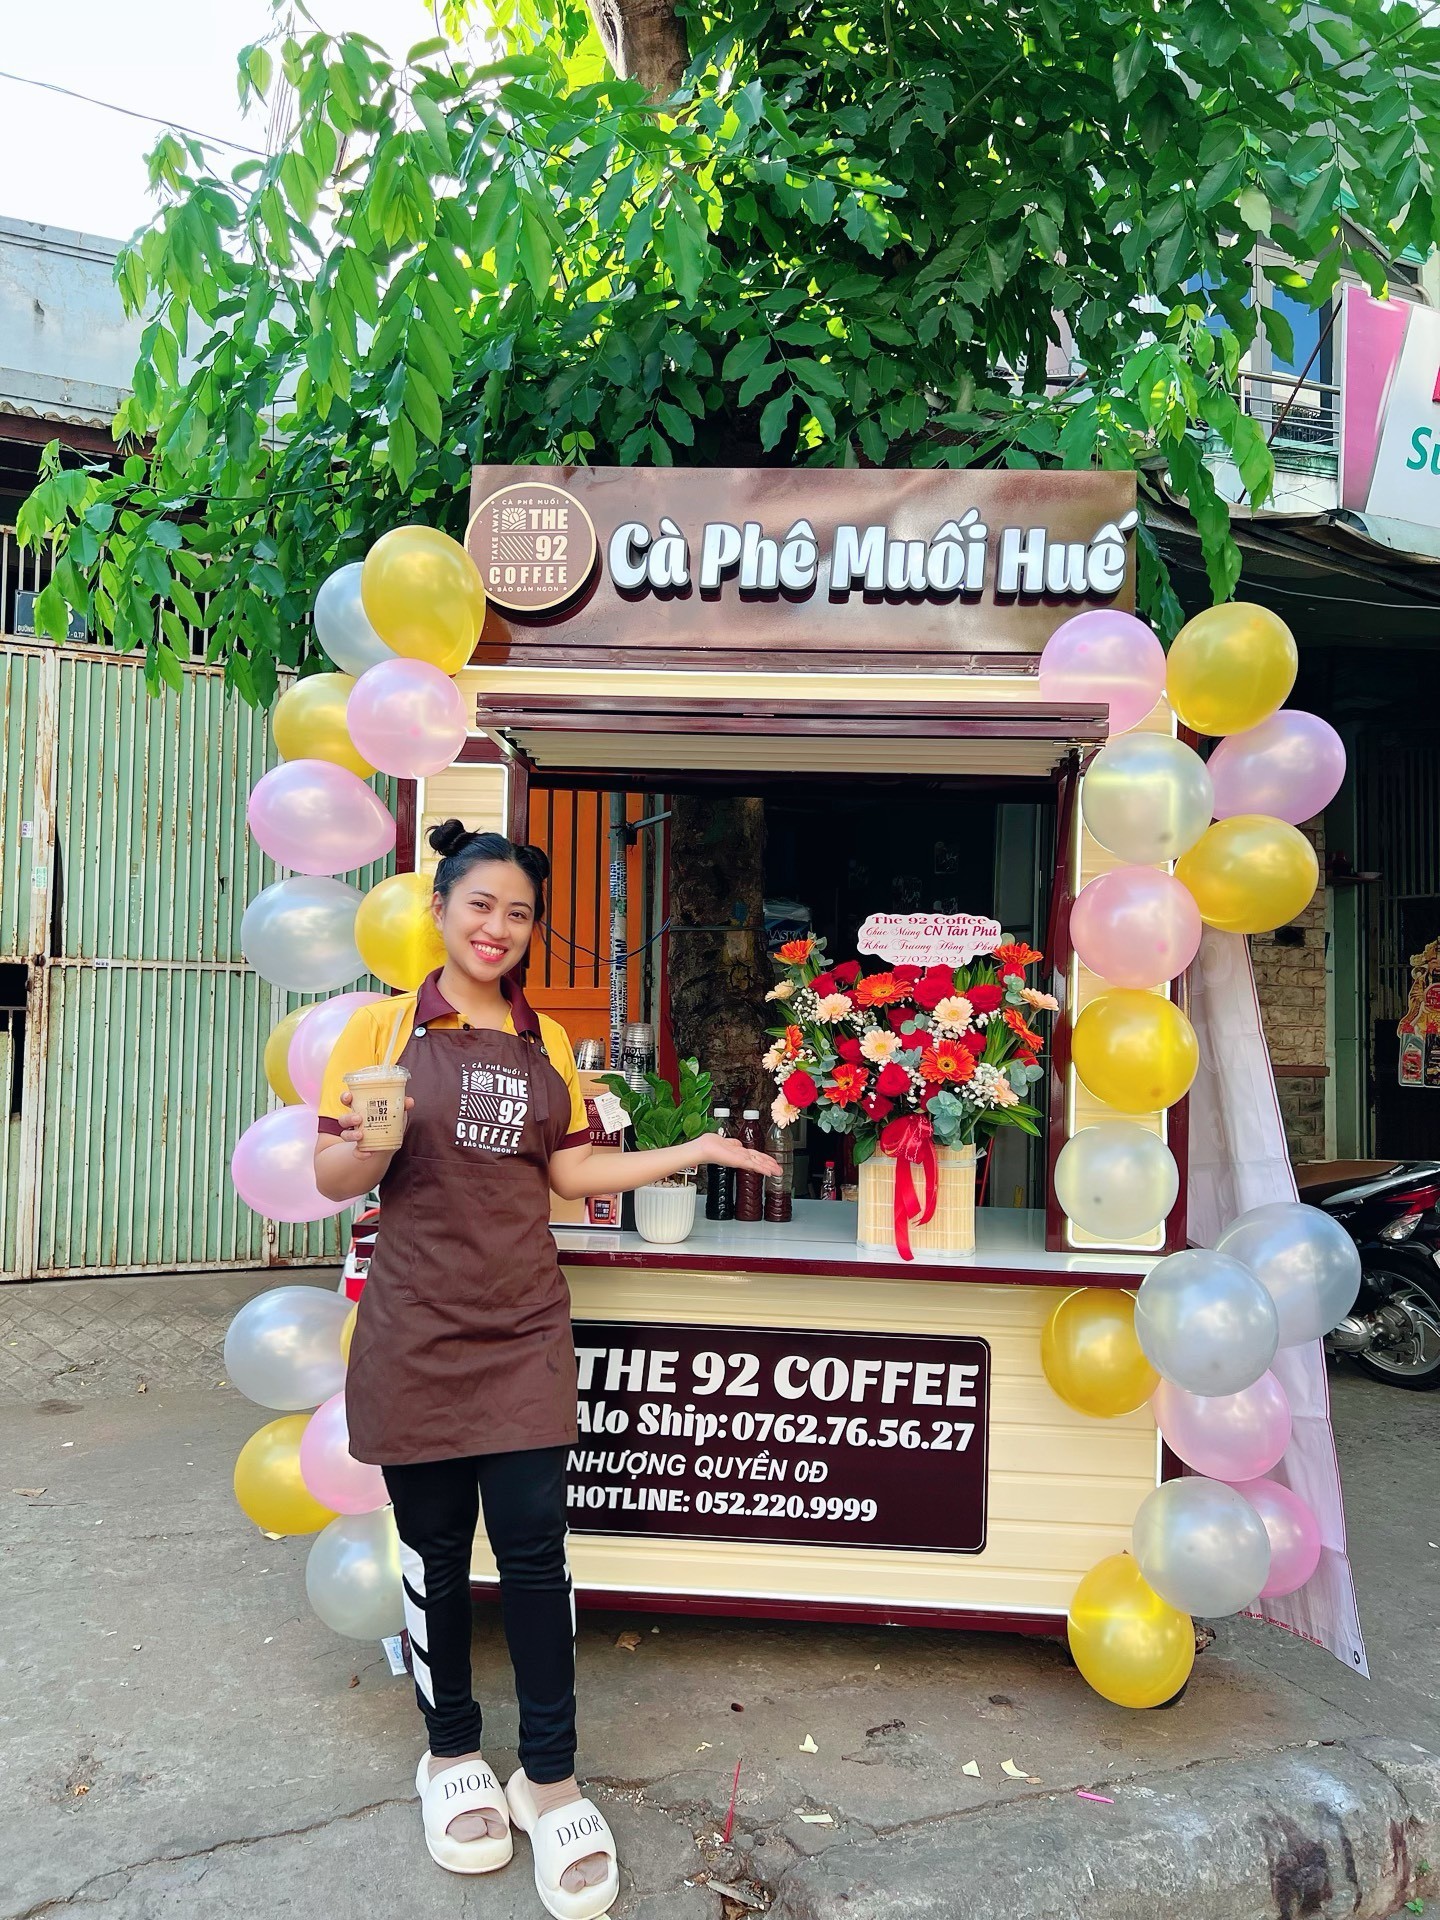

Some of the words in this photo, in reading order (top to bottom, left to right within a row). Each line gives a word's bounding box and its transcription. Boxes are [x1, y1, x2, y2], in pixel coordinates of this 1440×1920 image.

[538, 497, 560, 505] MUỐI
[492, 508, 500, 533] AWAY
[529, 508, 568, 530] THE
[535, 535, 568, 561] 92
[607, 515, 690, 592] Cà
[700, 517, 818, 591] Phê
[830, 507, 987, 592] Muối
[998, 508, 1140, 593] Huế
[489, 566, 568, 585] COFFEE
[872, 916, 902, 925] The
[908, 916, 928, 925] 92
[934, 916, 987, 925] Coffee
[924, 925, 943, 936] CN
[948, 925, 968, 936] Tân
[972, 925, 998, 937] Phú
[860, 938, 889, 950] Khai
[892, 955, 965, 963] 27/02/2024
[486, 1063, 500, 1071] PHÊ
[503, 1067, 520, 1076] MUỐI
[495, 1073, 529, 1098] THE
[379, 1107, 388, 1115] 92
[459, 1093, 468, 1116] TAKE
[497, 1099, 528, 1126] 92
[456, 1122, 522, 1148] COFFEE
[589, 1131, 618, 1141] OFFEE
[574, 1347, 679, 1393] THE
[692, 1351, 760, 1397] 92
[773, 1355, 980, 1408] COFFEE
[577, 1400, 630, 1434] Alo
[565, 1449, 687, 1480] NHƯỢNG
[694, 1449, 789, 1483] QUYỀN
[566, 1485, 691, 1513] HOTLINE:
[695, 1490, 878, 1522] 052.220.9999
[443, 1772, 495, 1801] DIOR
[556, 1813, 604, 1848] DIOR
